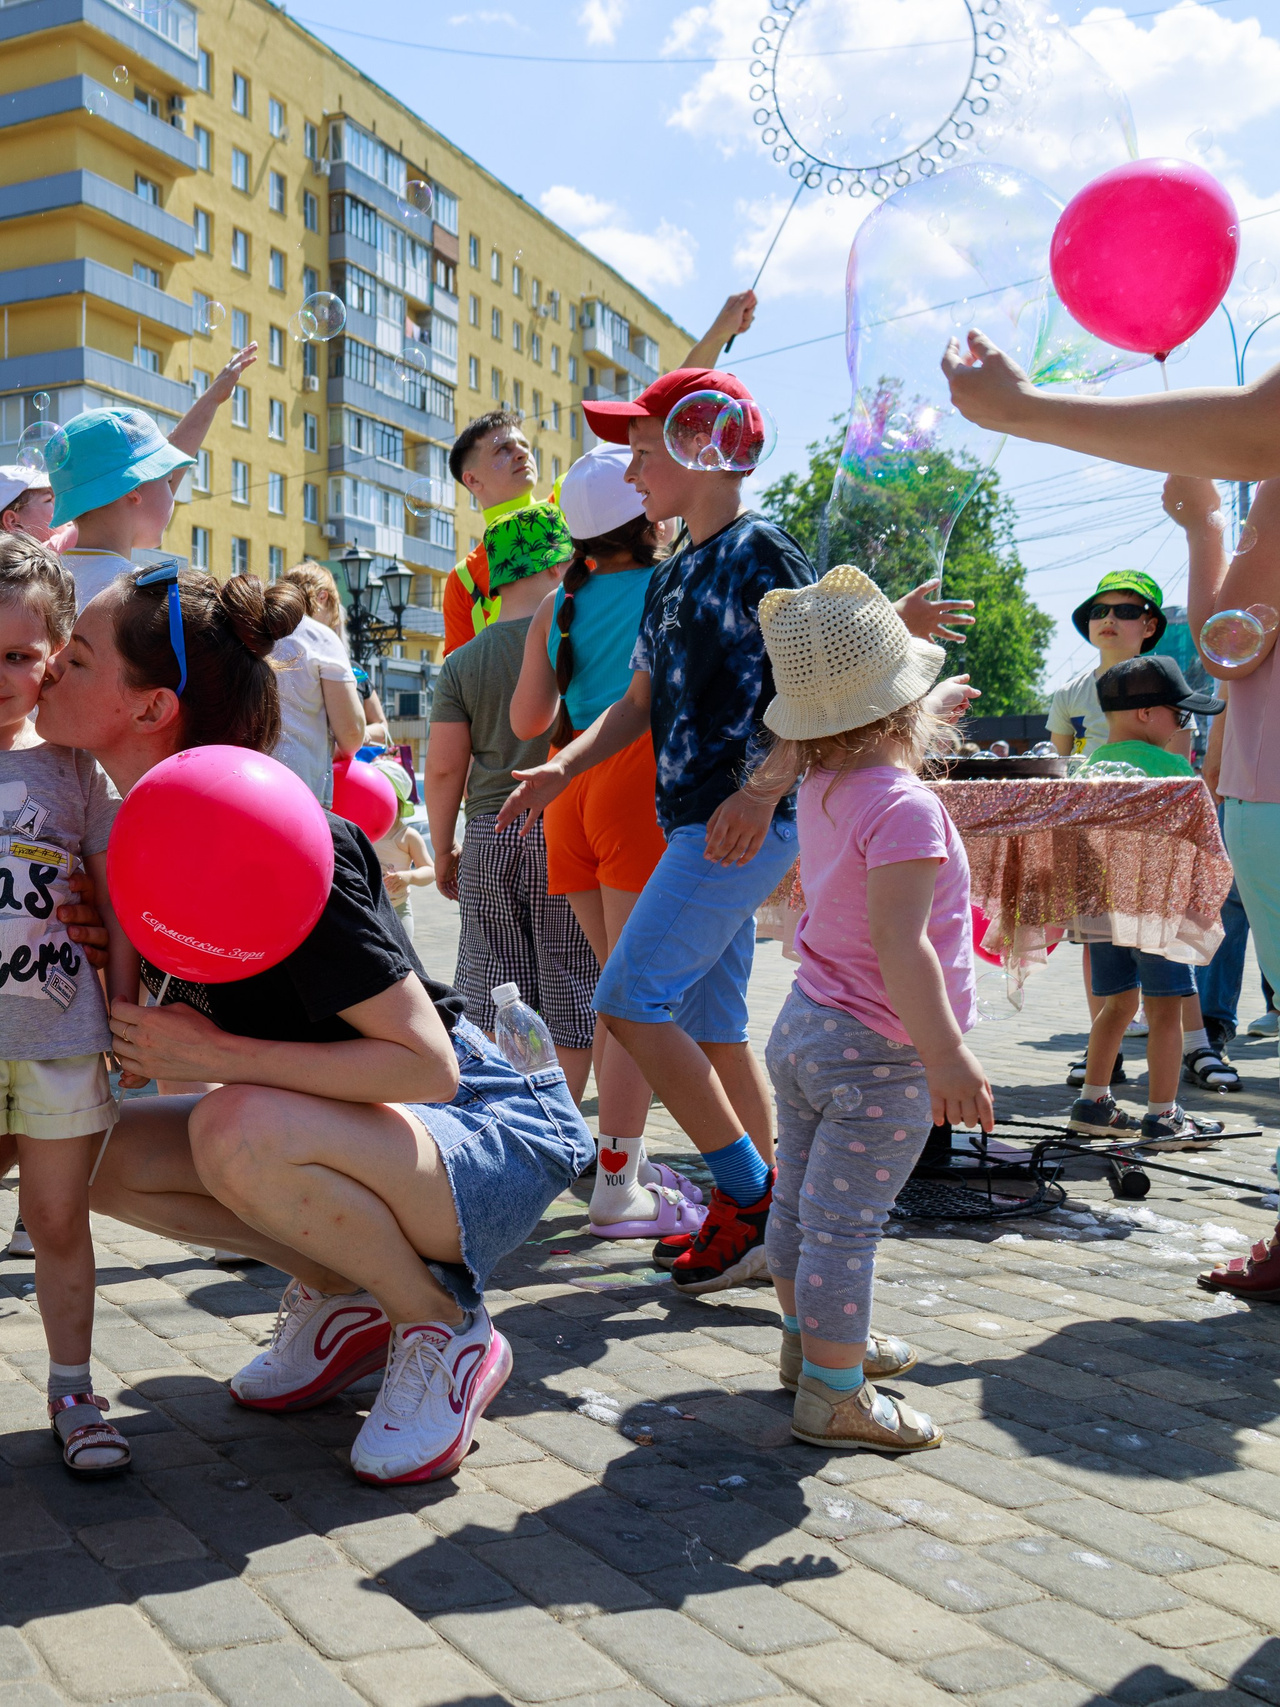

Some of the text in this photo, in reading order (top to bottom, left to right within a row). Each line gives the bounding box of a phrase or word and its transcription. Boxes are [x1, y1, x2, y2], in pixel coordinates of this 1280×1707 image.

[142, 911, 225, 955] Сормовские
[612, 1137, 618, 1150] I
[605, 1174, 625, 1186] YOU
